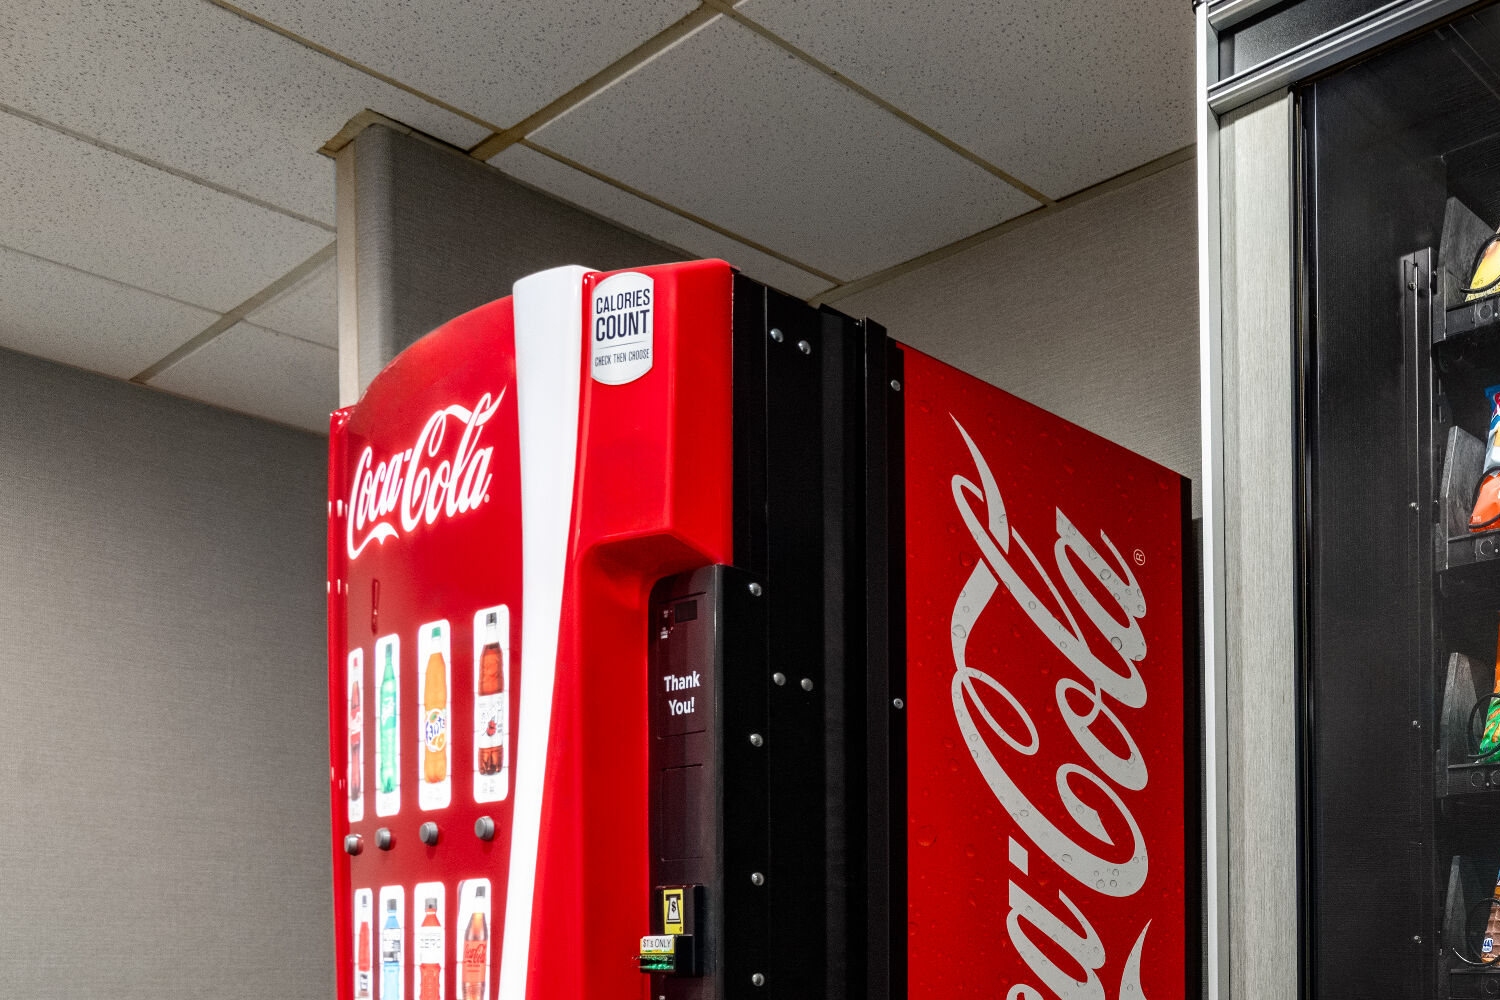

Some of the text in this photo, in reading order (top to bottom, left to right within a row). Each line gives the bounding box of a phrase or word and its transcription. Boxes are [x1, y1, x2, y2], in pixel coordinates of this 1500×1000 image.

[596, 288, 650, 314] CALORIES
[596, 309, 650, 341] COUNT
[595, 348, 650, 367] CHECK THEN CHOOSE
[664, 670, 700, 692] Thank
[668, 696, 695, 716] You!
[655, 938, 672, 948] ONLY
